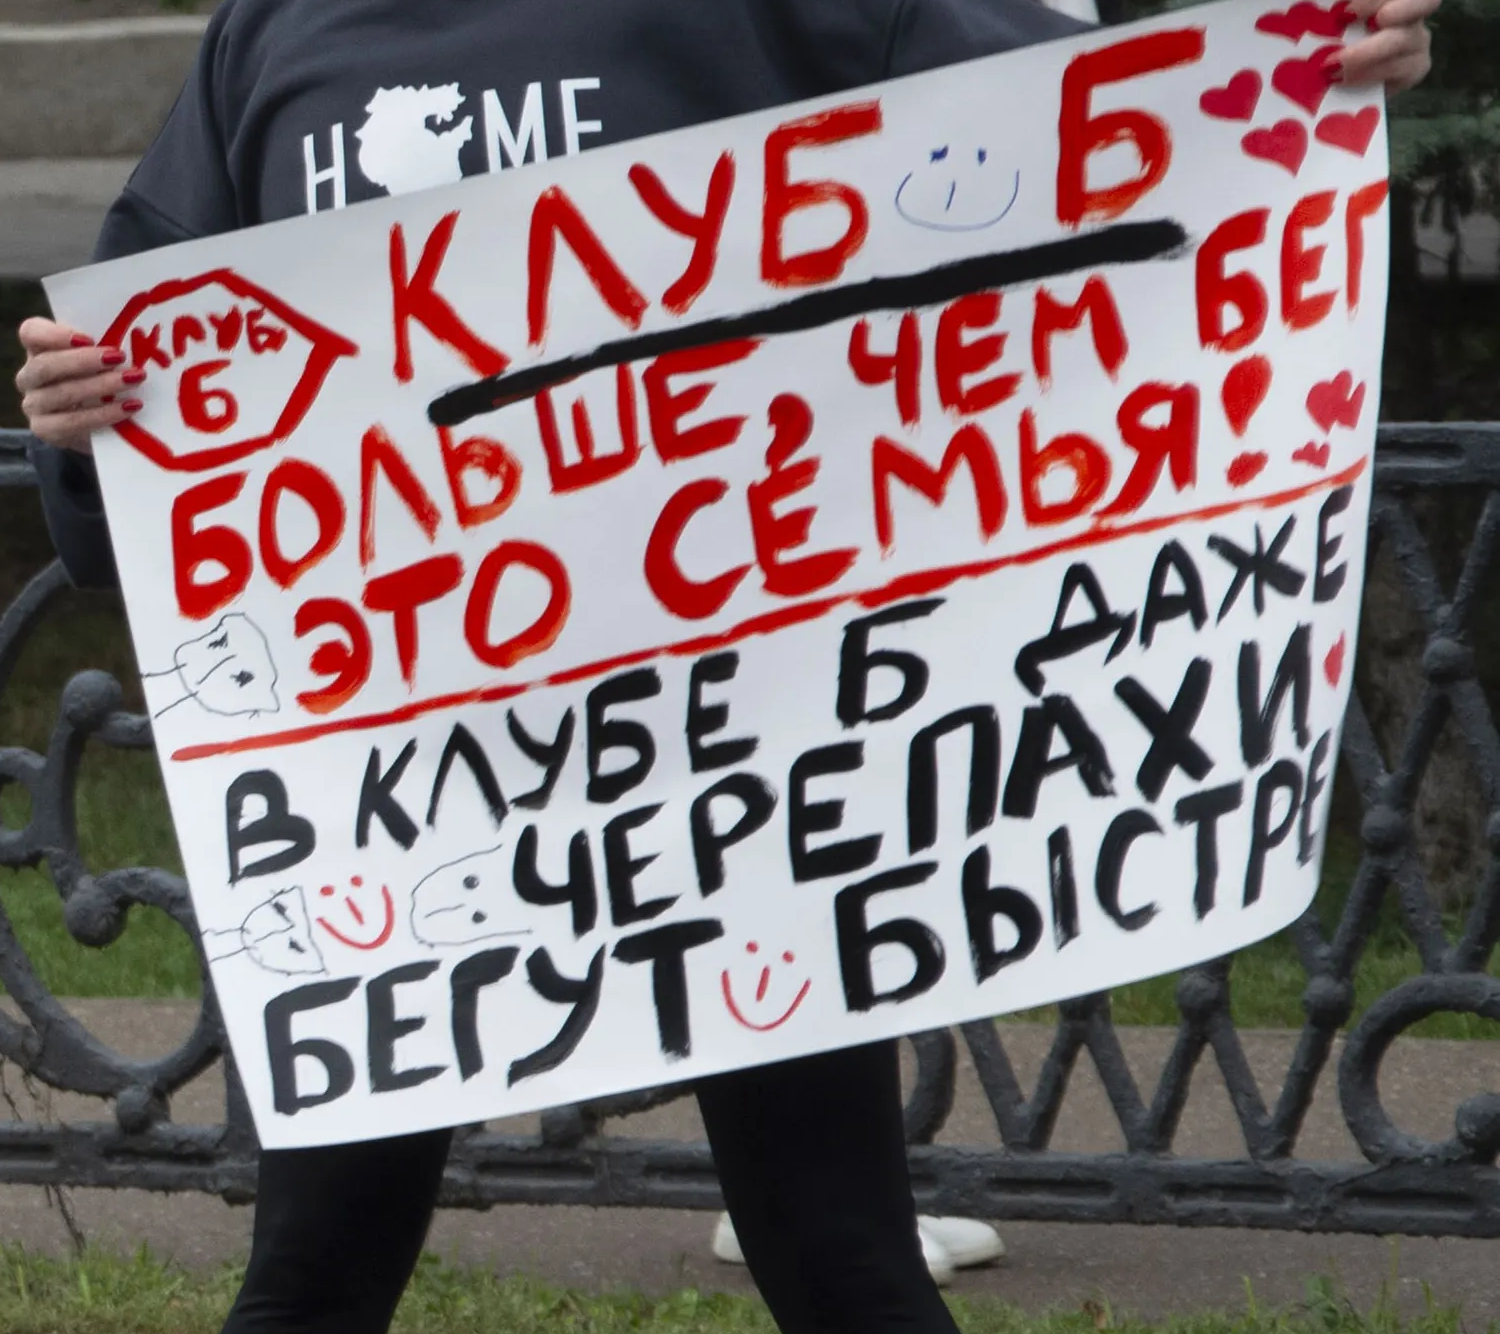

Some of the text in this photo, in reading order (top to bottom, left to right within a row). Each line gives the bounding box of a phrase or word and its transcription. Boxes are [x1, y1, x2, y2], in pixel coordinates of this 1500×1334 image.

[131, 305, 288, 369] КЛУБ
[390, 26, 1207, 384] КЛУБ Б
[171, 179, 1388, 618] БОЛЬШЕ, ЧЕМ БЕГ
[295, 354, 1273, 713] ЭТО СЕМЬЯ!
[225, 484, 1354, 886] В КЛУБЕ Б ДАЖЕ
[513, 622, 1313, 940] ЧЕРЕПАХИ
[264, 917, 725, 1115] БЕГУТ
